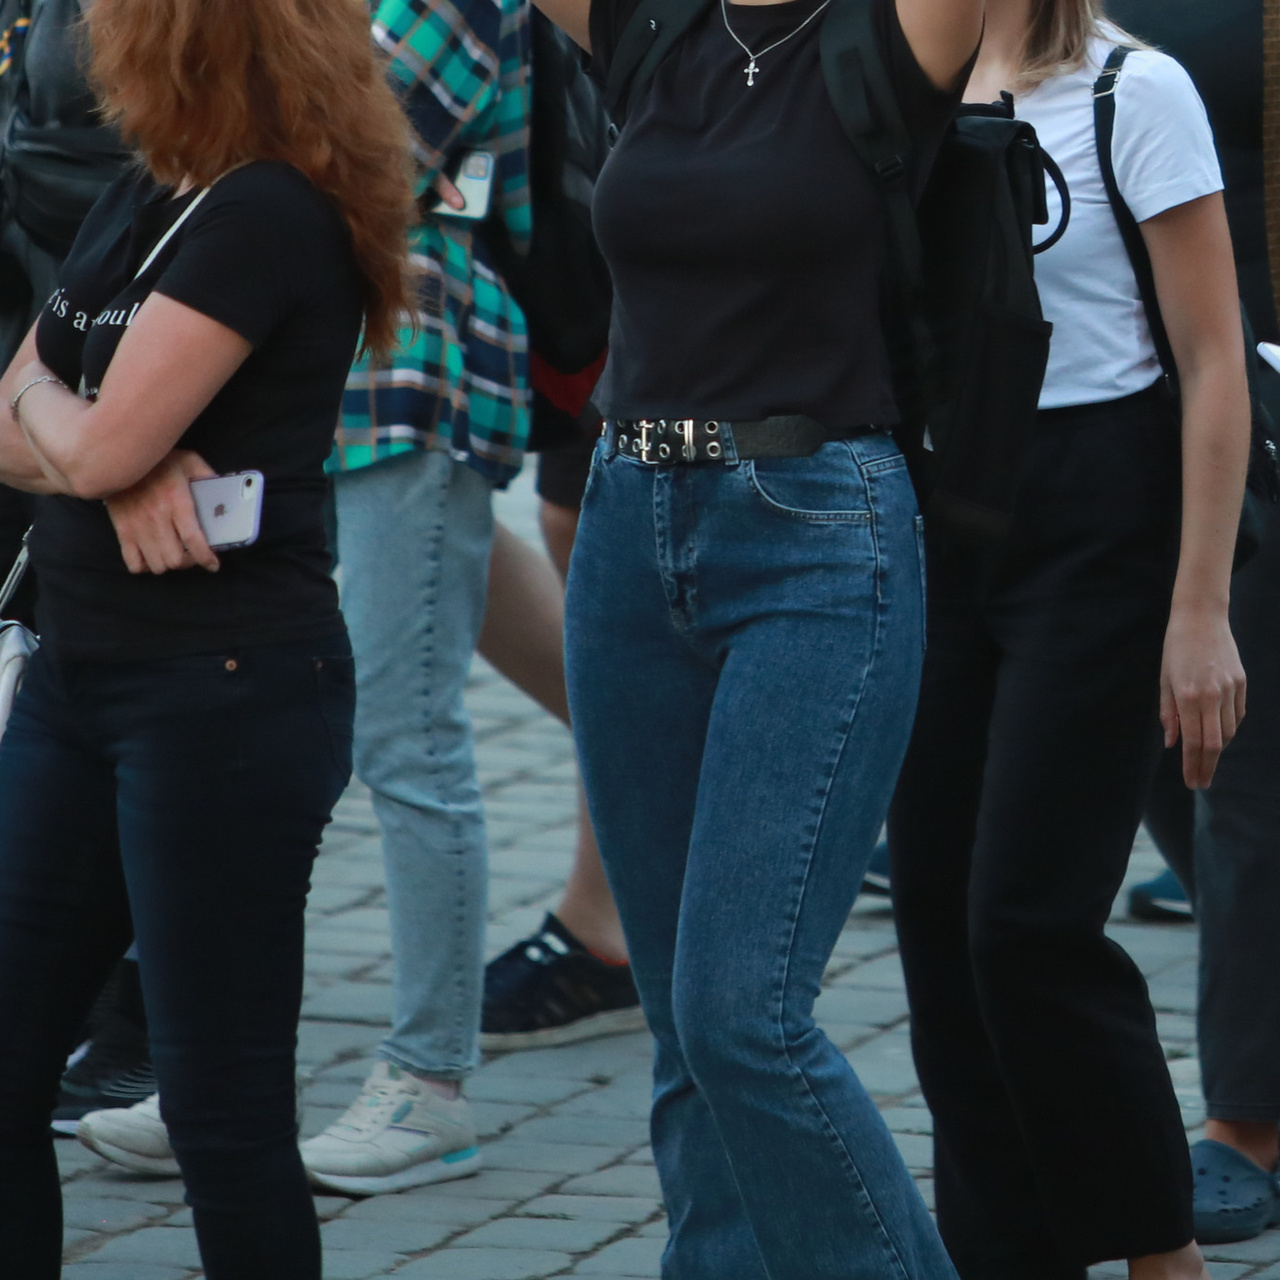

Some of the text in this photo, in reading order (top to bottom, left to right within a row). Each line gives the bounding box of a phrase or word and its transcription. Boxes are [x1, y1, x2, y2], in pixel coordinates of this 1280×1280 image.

[52, 288, 69, 318] is
[73, 311, 88, 331] a
[92, 302, 140, 326] oul
